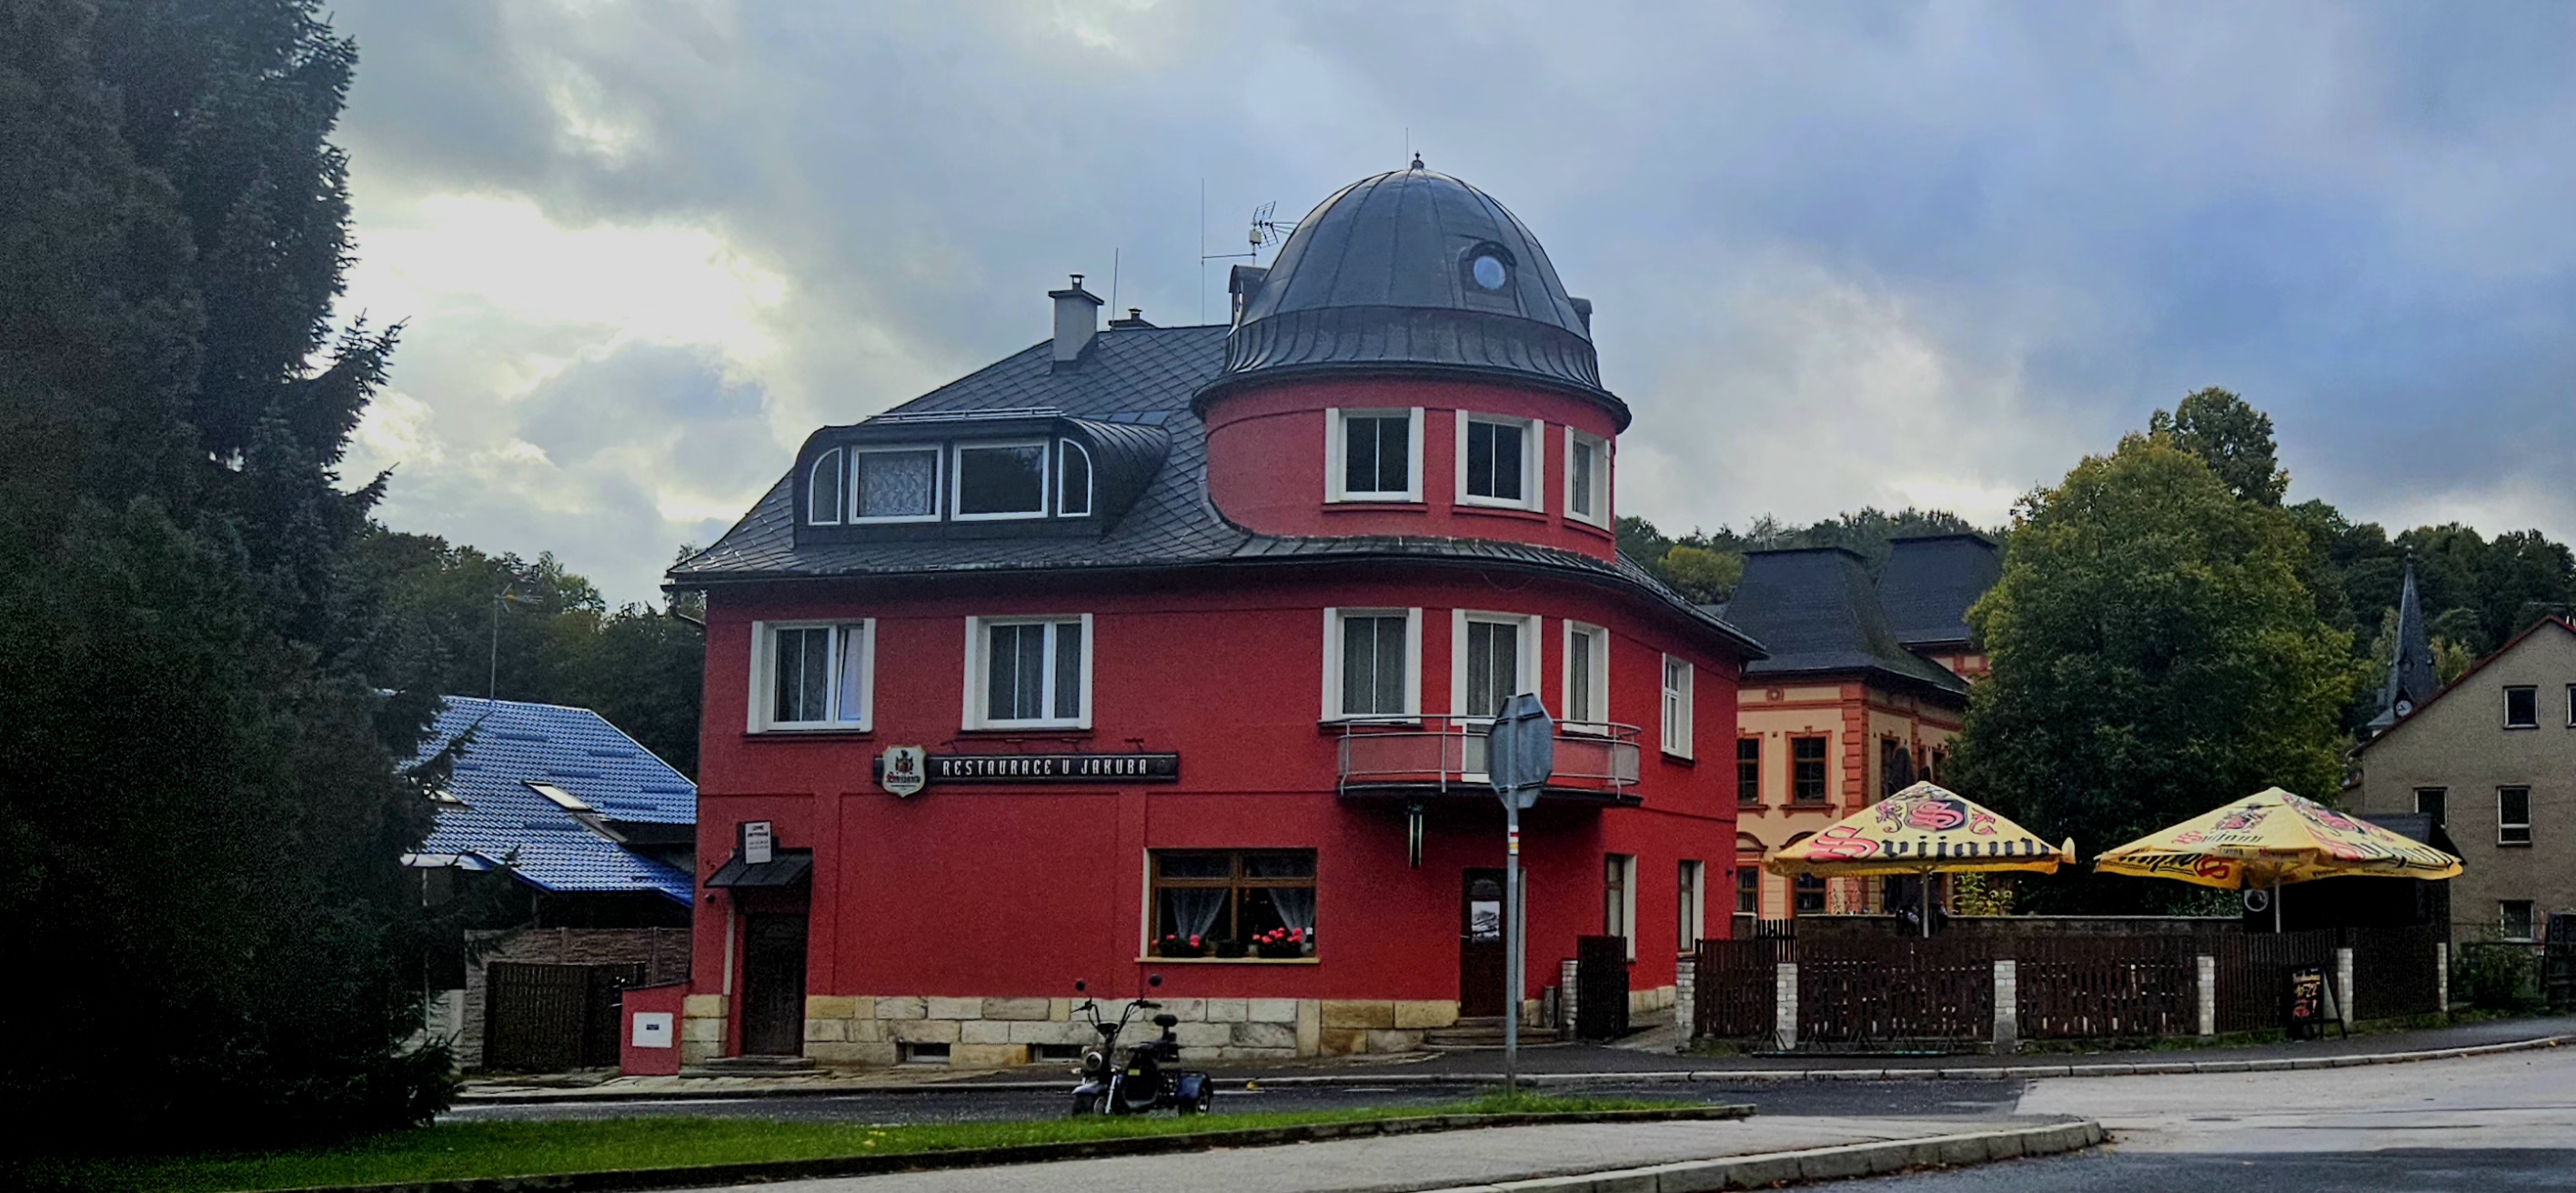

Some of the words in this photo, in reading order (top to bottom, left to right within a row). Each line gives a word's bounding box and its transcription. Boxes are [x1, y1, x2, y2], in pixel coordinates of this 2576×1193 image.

[942, 760, 1052, 776] RESTAURACE
[1062, 759, 1070, 774] U
[1081, 759, 1147, 775] JAKUBA
